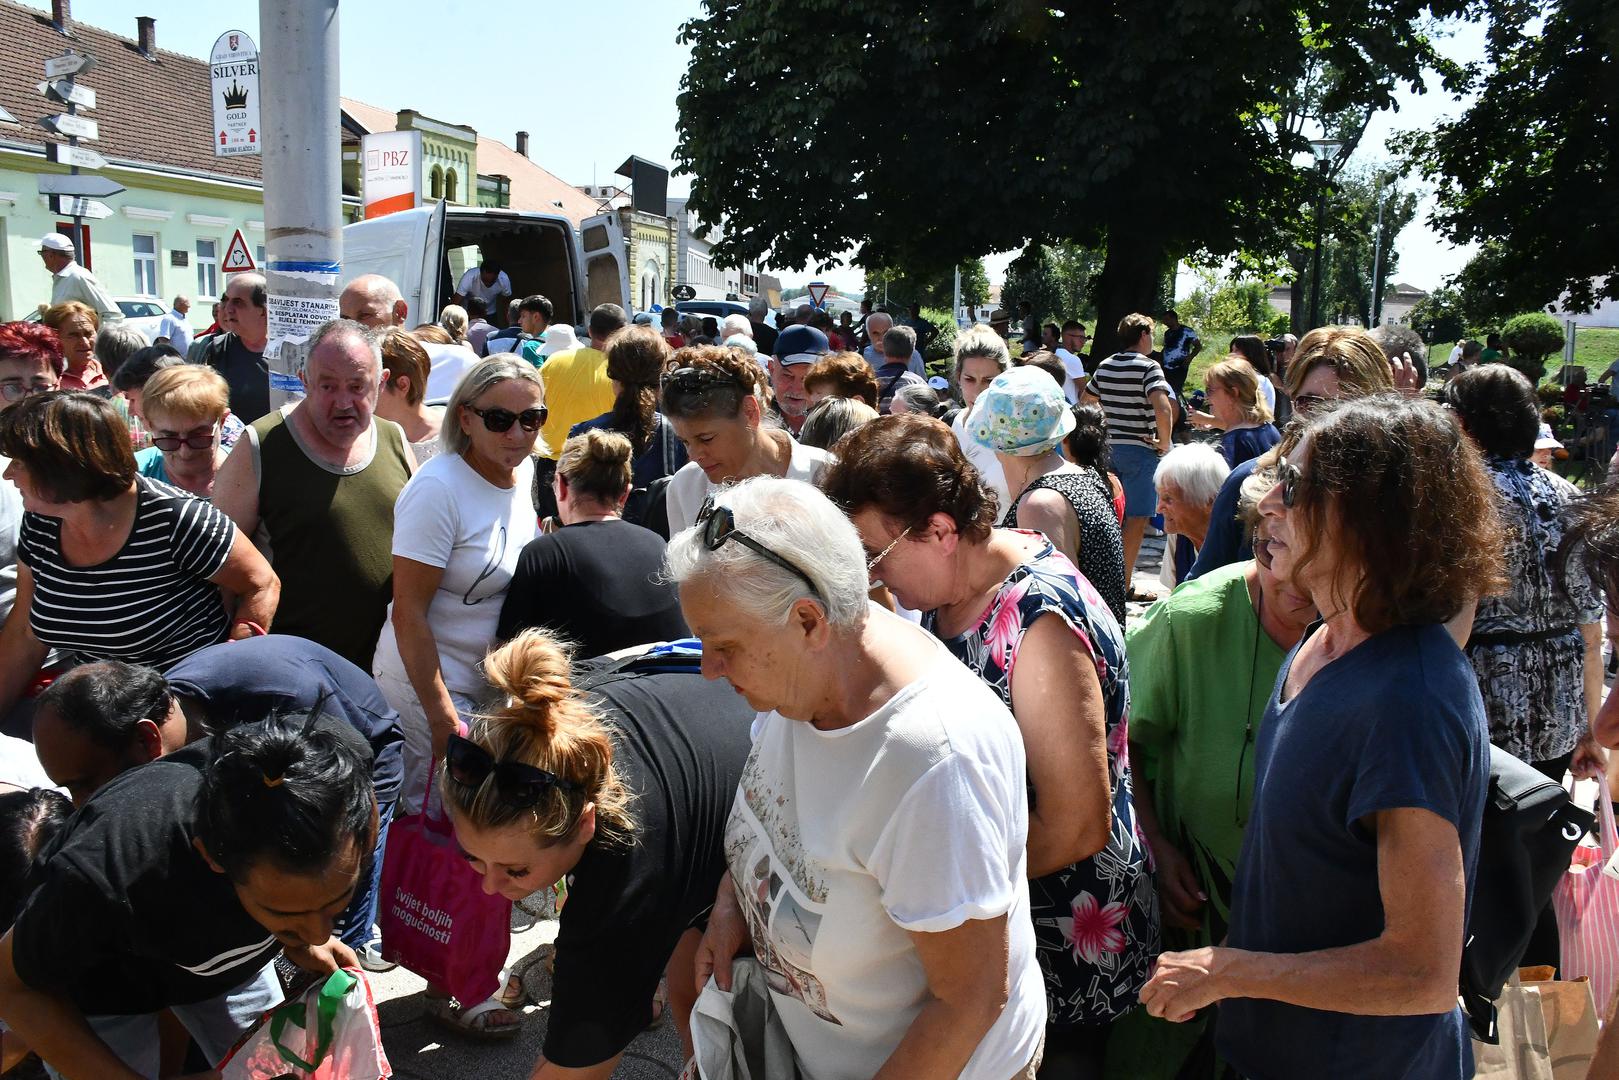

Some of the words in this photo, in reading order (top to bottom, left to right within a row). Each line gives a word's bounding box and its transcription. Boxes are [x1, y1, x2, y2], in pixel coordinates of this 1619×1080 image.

[213, 64, 257, 78] SILVER
[226, 112, 247, 121] GOLD
[383, 151, 409, 167] PBZ
[300, 301, 338, 310] STANARI
[275, 310, 309, 319] BESPLATAN
[278, 316, 297, 324] BIJELE
[395, 886, 422, 913] Svijet
[421, 902, 453, 929] boljih
[391, 905, 453, 945] mogućnosti
